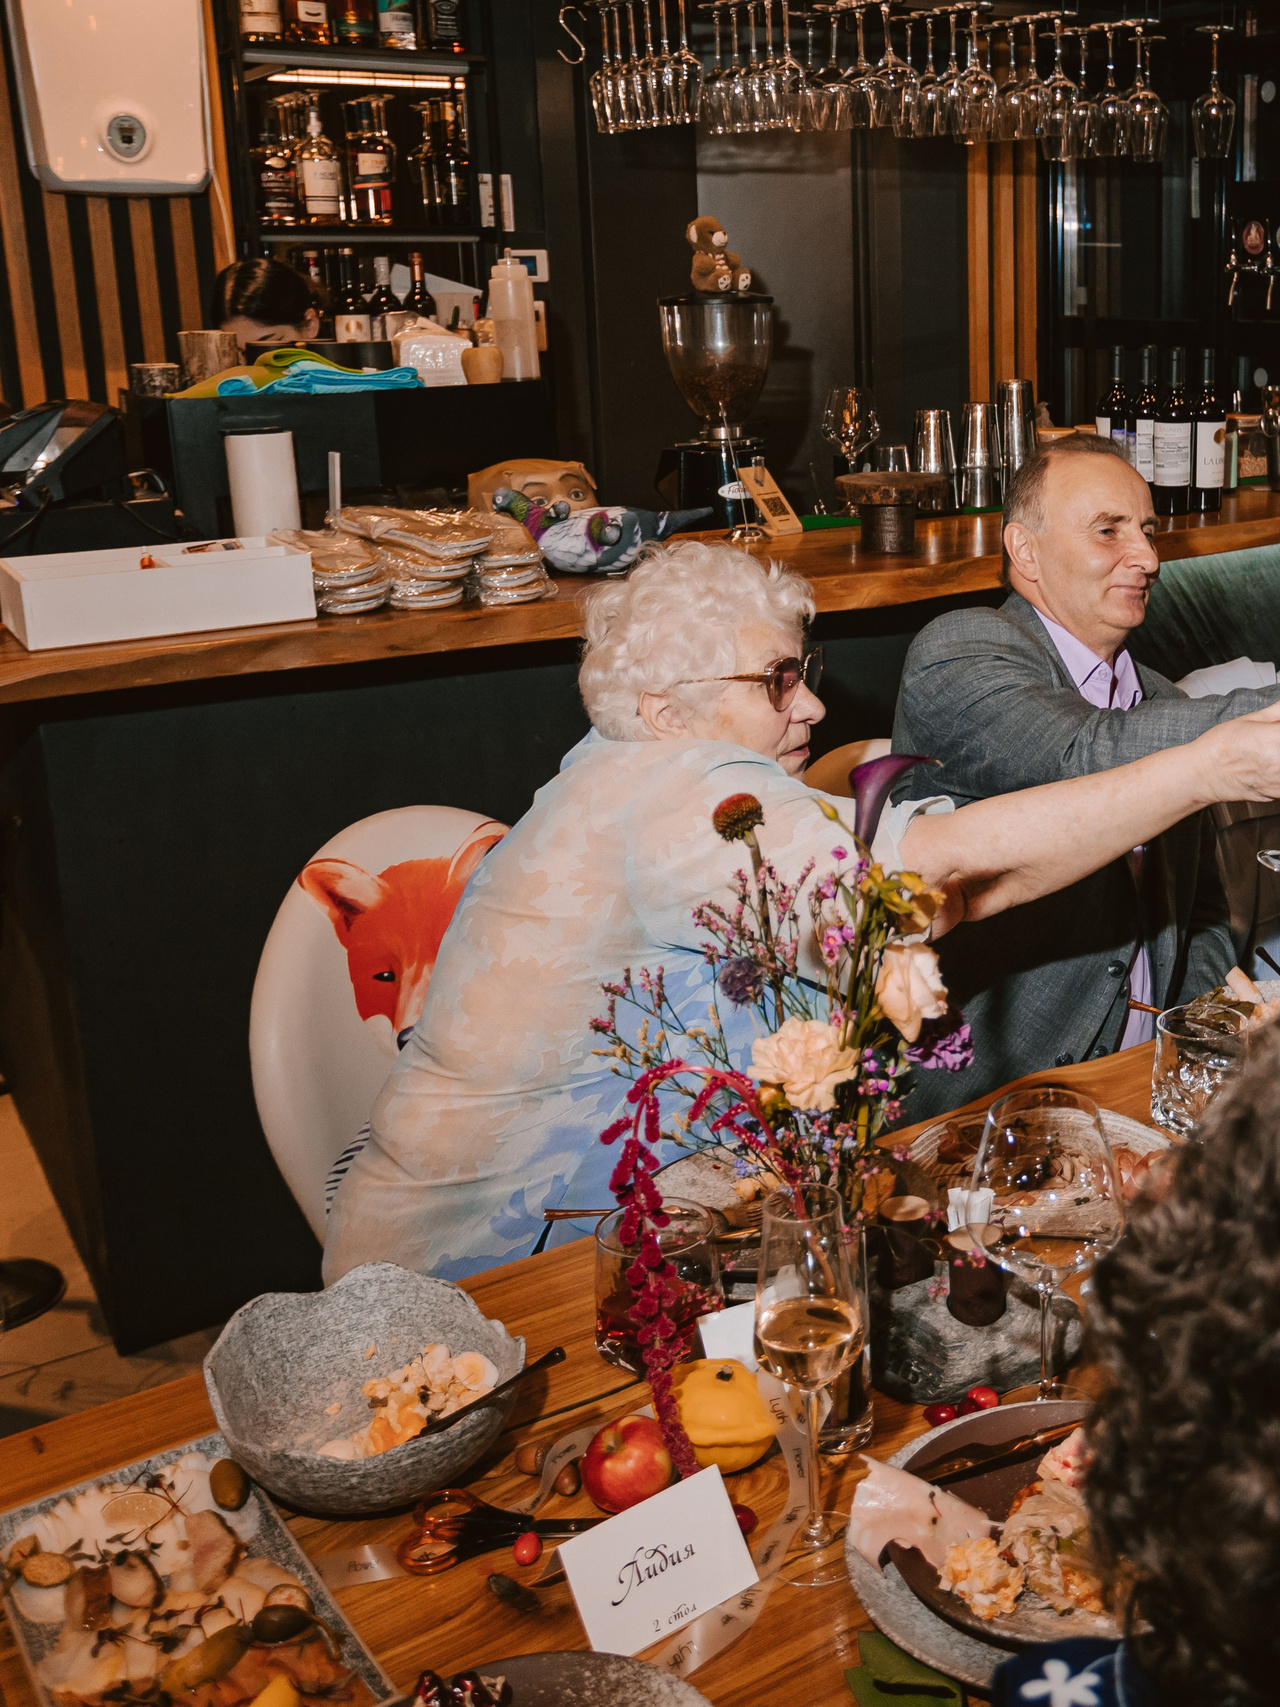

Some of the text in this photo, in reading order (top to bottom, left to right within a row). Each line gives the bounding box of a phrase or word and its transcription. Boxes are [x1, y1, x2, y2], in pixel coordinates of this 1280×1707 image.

[611, 1543, 697, 1607] Лидия
[652, 1602, 698, 1633] 2 стол
